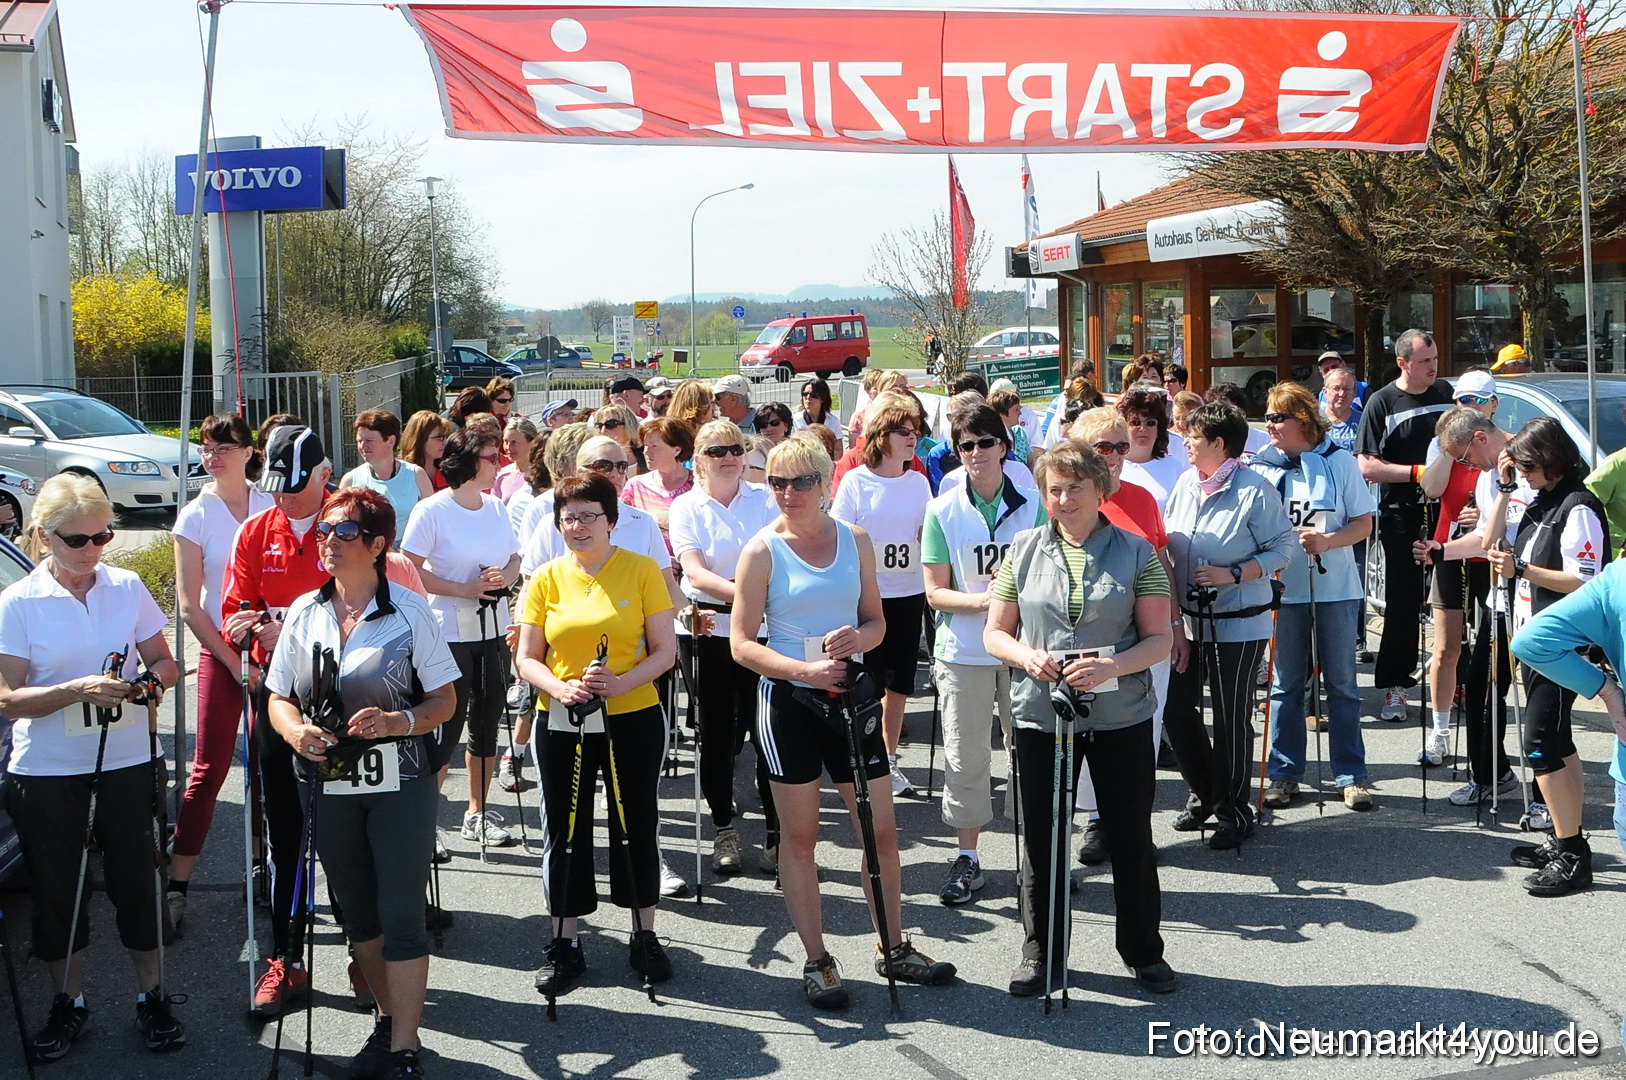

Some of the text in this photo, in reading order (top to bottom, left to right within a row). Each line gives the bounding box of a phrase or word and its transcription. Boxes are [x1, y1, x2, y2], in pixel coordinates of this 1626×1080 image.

[187, 166, 302, 191] VOLVO
[1154, 230, 1193, 249] Autohaus
[1043, 245, 1070, 262] SEAT
[1010, 374, 1032, 382] Action
[1019, 379, 1046, 388] Bahnen!
[1289, 500, 1316, 527] 52
[884, 543, 910, 569] 83
[341, 748, 384, 787] 49
